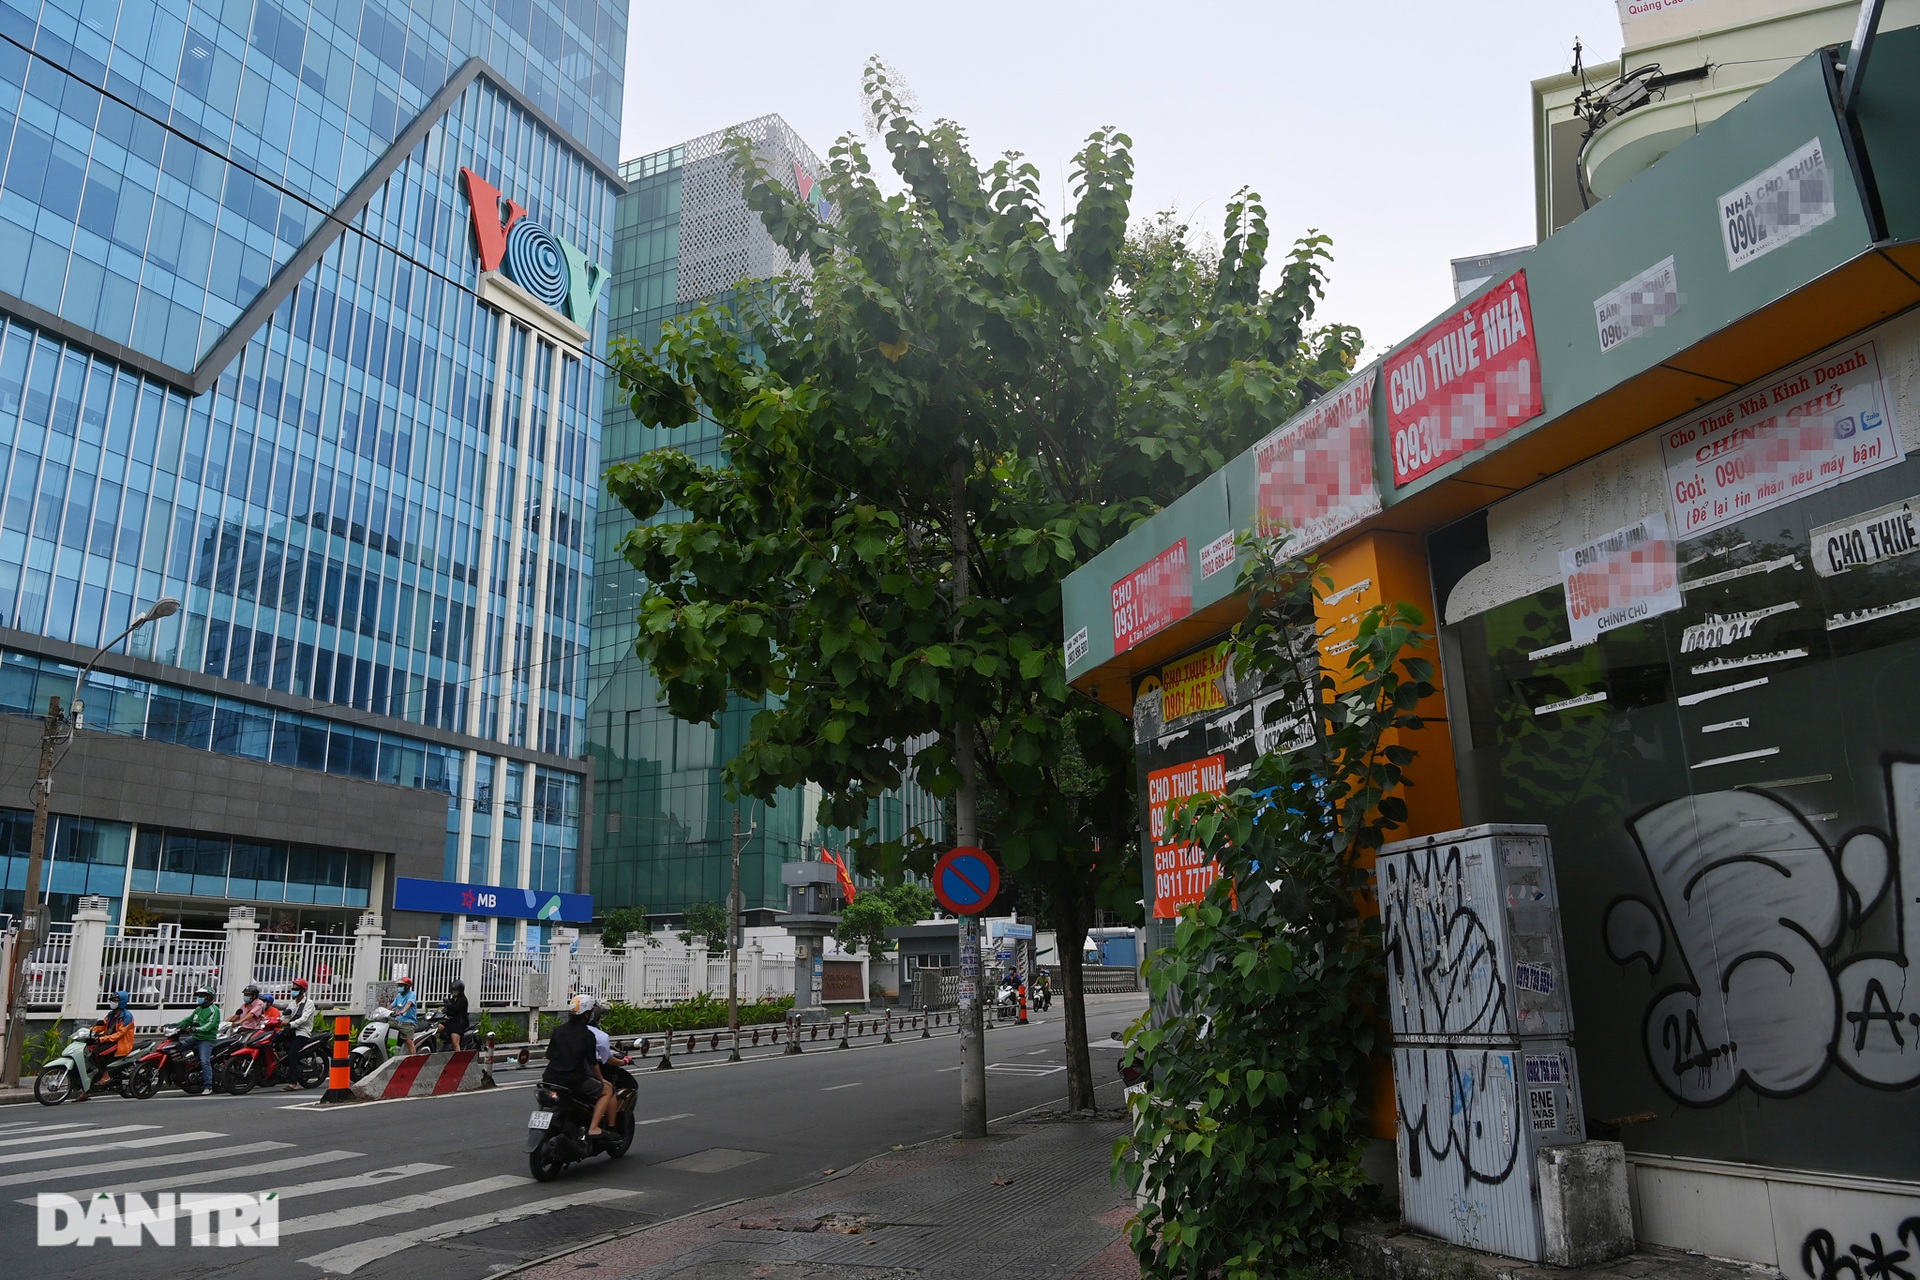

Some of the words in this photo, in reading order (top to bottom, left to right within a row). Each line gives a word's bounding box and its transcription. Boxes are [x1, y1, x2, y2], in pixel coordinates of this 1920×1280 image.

[1725, 191, 1754, 219] NHÀ
[1785, 149, 1823, 182] THUÊ
[1390, 353, 1427, 416] CHO
[1427, 309, 1480, 391] THUÊ
[1481, 279, 1527, 361] NHÀ
[1669, 430, 1696, 449] Cho
[1699, 406, 1735, 436] Thuê
[1738, 393, 1768, 420] Nhà
[1771, 375, 1811, 404] Kinh
[1813, 350, 1868, 385] Doanh
[1785, 383, 1845, 425] CHỦ
[1675, 473, 1707, 505] Gọi:
[1686, 501, 1710, 530] (Để
[1714, 499, 1729, 519] lại
[1734, 490, 1751, 509] tin
[1791, 468, 1813, 487] nếu
[1820, 454, 1846, 476] máy
[1853, 437, 1882, 466] bận)
[1574, 545, 1597, 569] CHO
[1827, 529, 1867, 573] CHO
[1866, 503, 1920, 560] THUÊ
[1112, 580, 1132, 610] CHO
[1134, 559, 1160, 596] THUÊ
[1163, 542, 1187, 576] NHÀ
[1597, 610, 1627, 630] CHÍNH
[1627, 600, 1648, 620] CHỦ
[1163, 667, 1182, 692] CHO
[1183, 652, 1208, 684] THUÊ
[1149, 776, 1169, 804] CHO
[1172, 763, 1199, 799] THUÊ
[1201, 757, 1225, 793] NHÀ
[1155, 850, 1176, 871] CHO
[477, 893, 497, 908] MB
[1157, 870, 1183, 899] 0911
[1185, 865, 1214, 895] 7777
[1532, 1108, 1555, 1119] WAS
[1533, 1119, 1556, 1130] HERE
